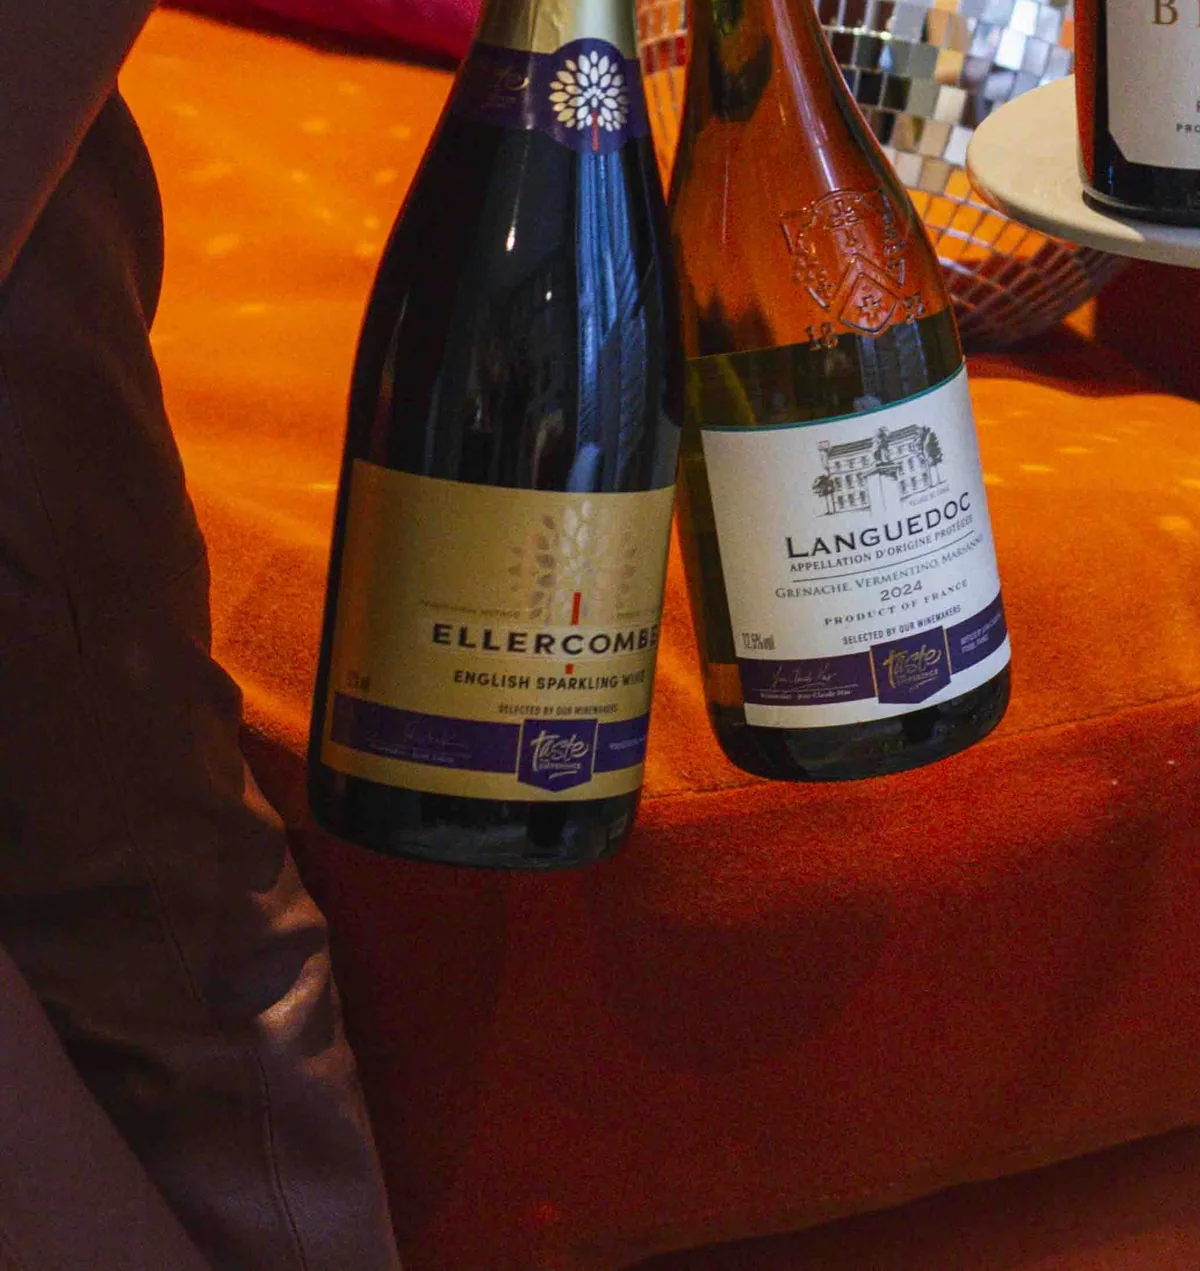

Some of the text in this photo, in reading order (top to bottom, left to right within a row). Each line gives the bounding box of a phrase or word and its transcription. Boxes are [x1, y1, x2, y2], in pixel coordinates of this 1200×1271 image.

[785, 491, 971, 559] LANGUEDOC
[790, 552, 872, 573] APPELLATION
[875, 535, 932, 559] D'ORIGINE
[824, 579, 968, 626] PRODUCT OF FRANCE
[880, 579, 923, 601] 2024
[842, 629, 884, 646] SELECTED
[886, 627, 897, 637] BY
[900, 621, 915, 633] OUR
[454, 670, 530, 689] ENGLISH
[535, 674, 619, 690] SPARKLING
